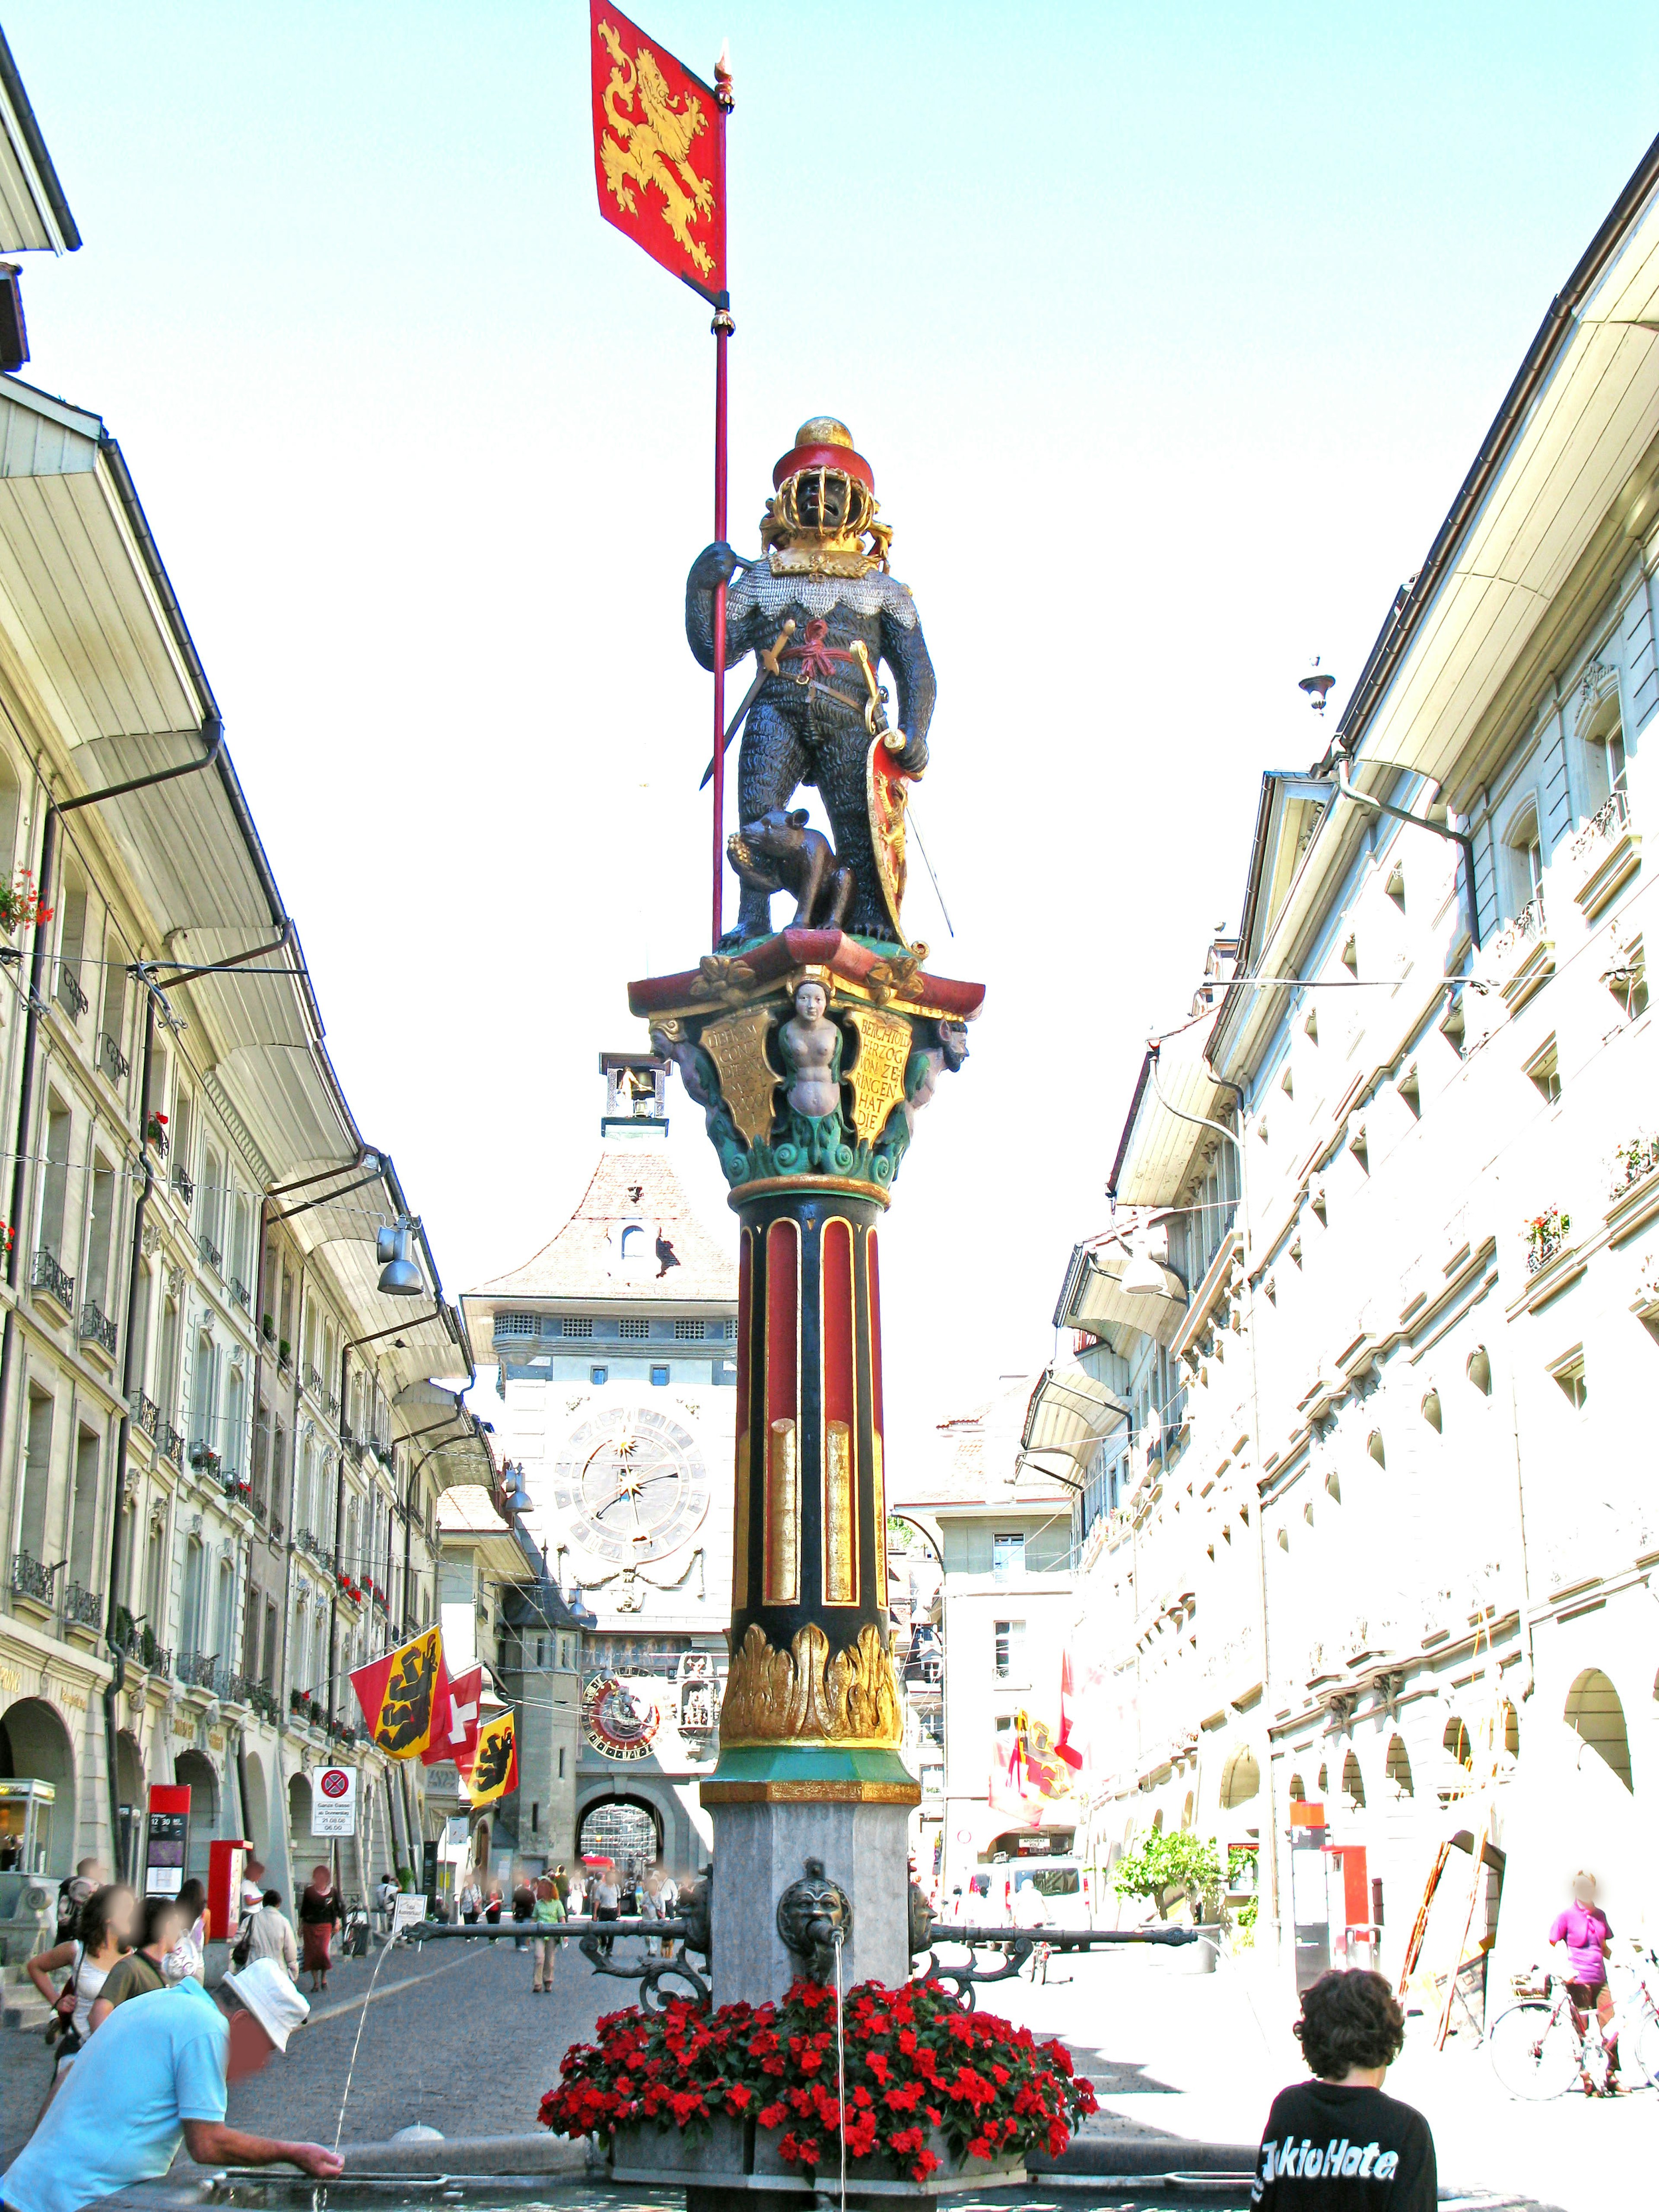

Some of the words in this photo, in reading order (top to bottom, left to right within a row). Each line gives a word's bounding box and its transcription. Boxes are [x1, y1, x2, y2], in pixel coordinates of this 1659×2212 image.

[863, 1038, 903, 1064] HERZOG
[860, 1056, 878, 1076] VON
[855, 1072, 897, 1099] RINGEN
[858, 1092, 884, 1113] HAT
[857, 1110, 878, 1129] DIE
[1262, 2136, 1398, 2181] TkioHote
